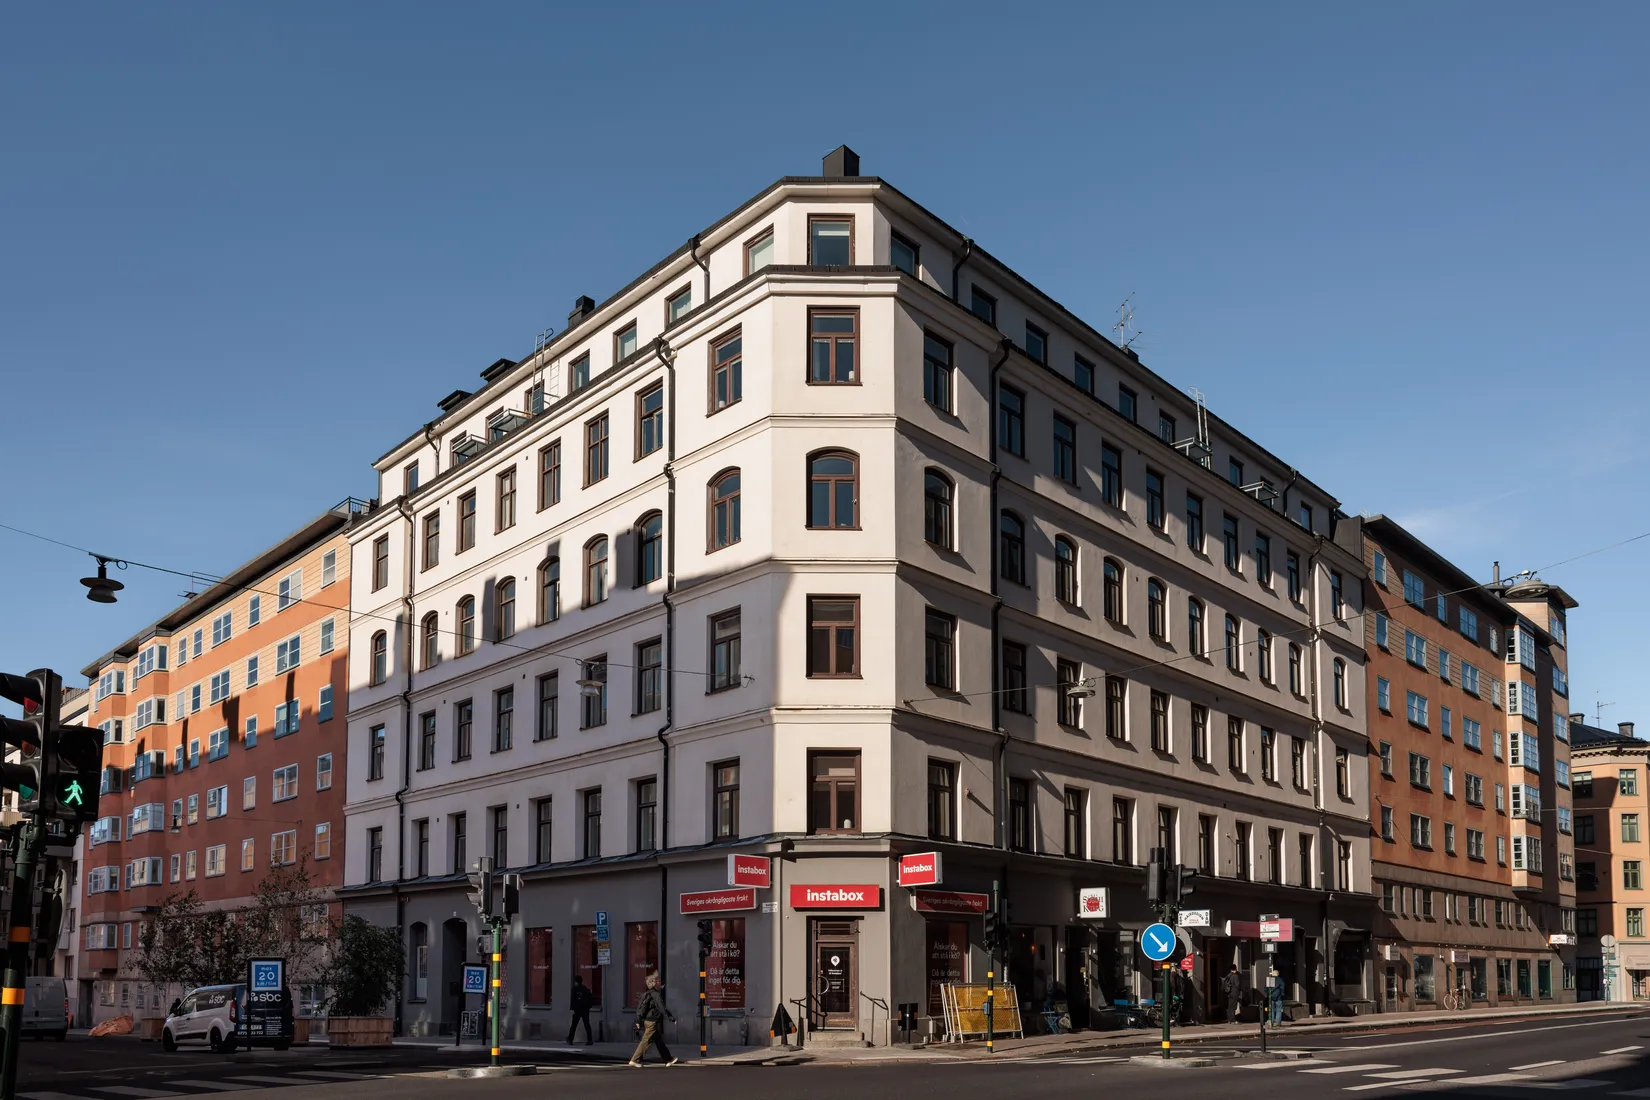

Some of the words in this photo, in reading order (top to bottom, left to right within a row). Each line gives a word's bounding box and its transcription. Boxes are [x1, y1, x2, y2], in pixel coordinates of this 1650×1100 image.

[737, 864, 767, 876] instabox
[903, 863, 933, 874] instabox
[806, 888, 865, 902] instabox
[686, 898, 705, 907] Sveriges
[598, 912, 606, 925] P
[712, 940, 729, 949] Älskar
[729, 941, 738, 949] du
[950, 942, 958, 951] du
[730, 948, 741, 958] kö?
[710, 966, 718, 975] Då
[725, 967, 740, 975] detta
[258, 971, 275, 981] 20
[468, 975, 482, 984] 20
[708, 976, 722, 986] inget
[722, 975, 731, 984] för
[259, 991, 282, 1002] sbc
